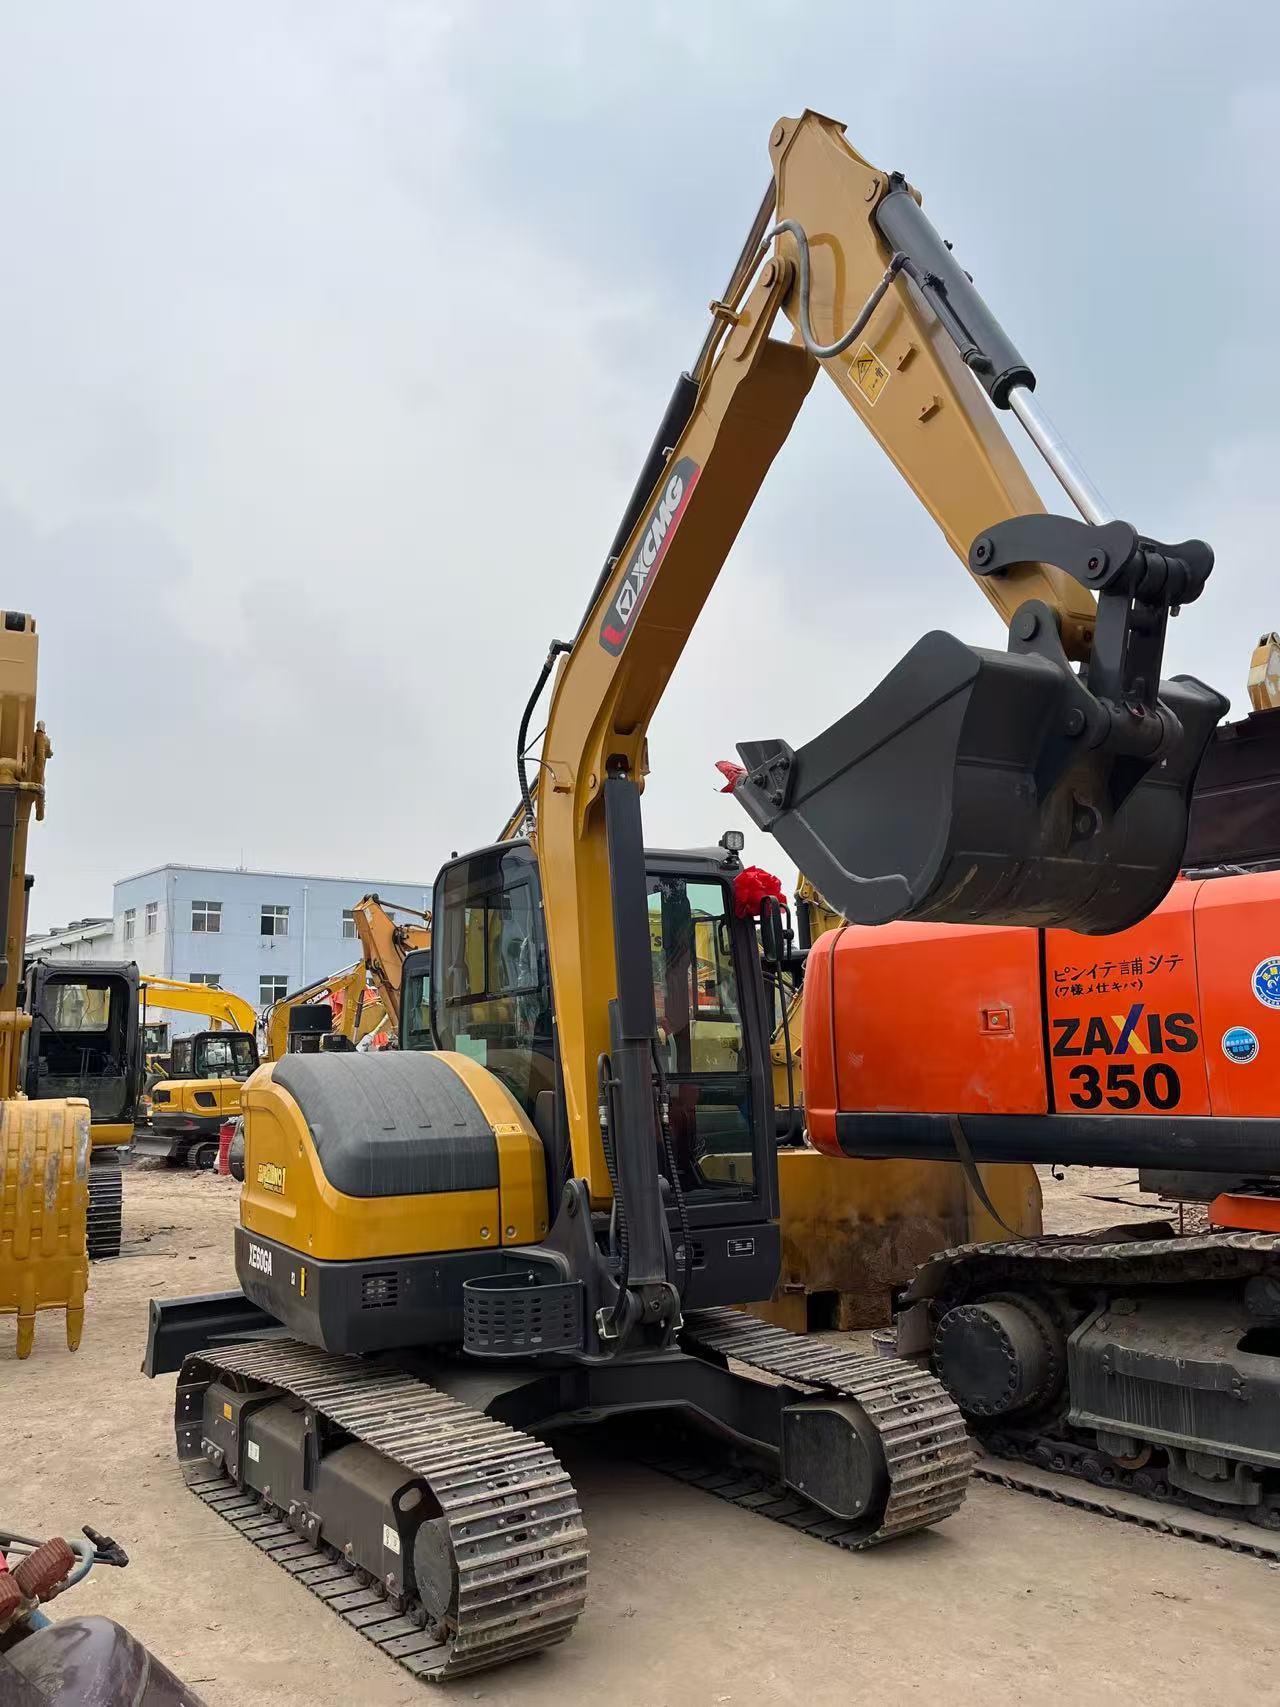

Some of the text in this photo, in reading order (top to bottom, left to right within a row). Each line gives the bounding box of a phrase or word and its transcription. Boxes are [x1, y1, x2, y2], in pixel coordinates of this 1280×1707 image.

[631, 474, 684, 597] XCMG
[1052, 1003, 1199, 1057] ZAXIS
[1069, 1063, 1181, 1110] 350
